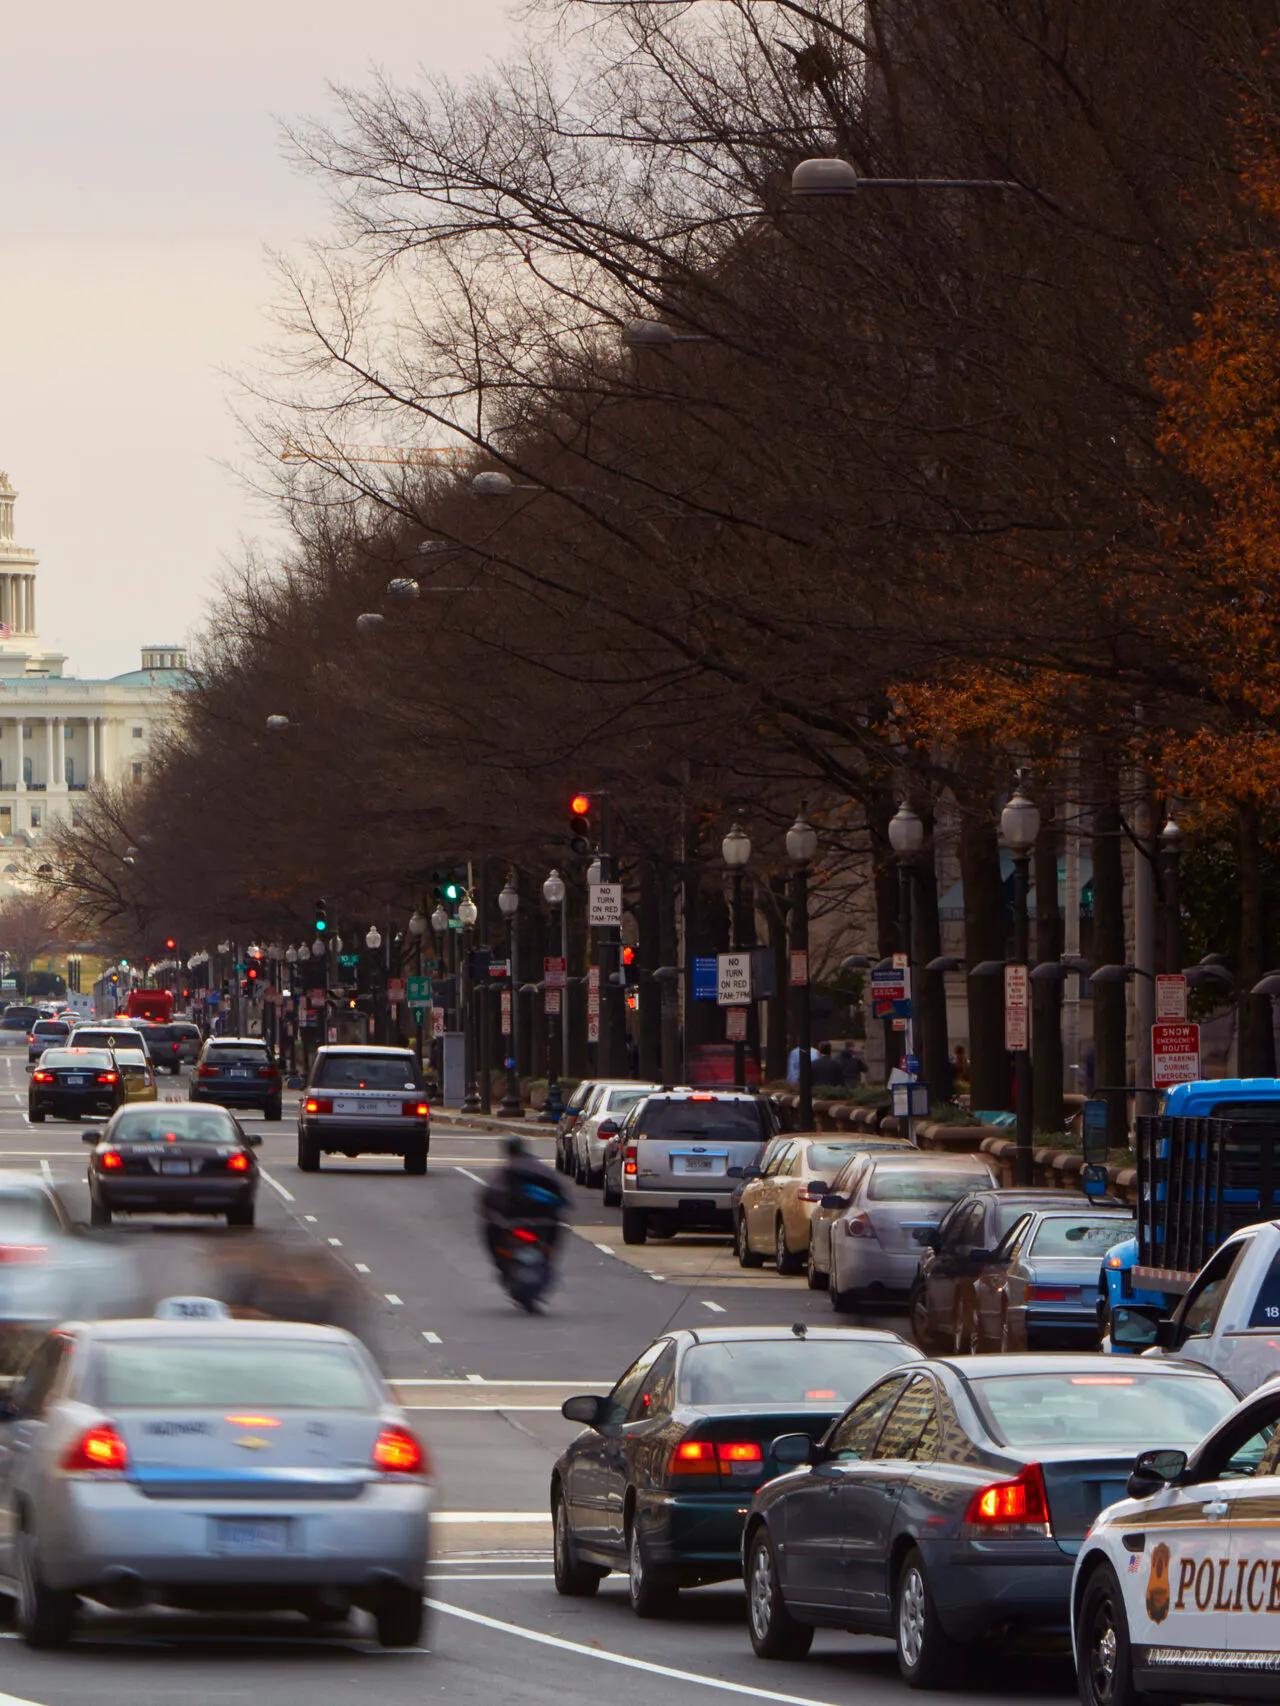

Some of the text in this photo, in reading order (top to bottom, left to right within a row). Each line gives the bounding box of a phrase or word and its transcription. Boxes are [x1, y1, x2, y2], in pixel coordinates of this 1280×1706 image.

[600, 887, 611, 895] NO
[597, 896, 615, 904] TURN
[592, 905, 618, 913] ON RED
[591, 914, 621, 922] 7AM-7PM
[728, 958, 739, 966] NO
[725, 969, 743, 978] TURN
[721, 980, 747, 990] ON RED
[720, 991, 751, 1000] 7AM-7PM
[1162, 1028, 1190, 1036] SNOW
[1157, 1037, 1195, 1045] EMERGENCY
[1164, 1063, 1190, 1071] DURING
[1157, 1072, 1197, 1080] EMERGENCY
[1264, 1306, 1280, 1318] 18
[1175, 1558, 1280, 1613] POLICE
[1148, 1648, 1181, 1666] UNITED
[1179, 1649, 1211, 1667] STATES
[1209, 1650, 1246, 1668] SECRET
